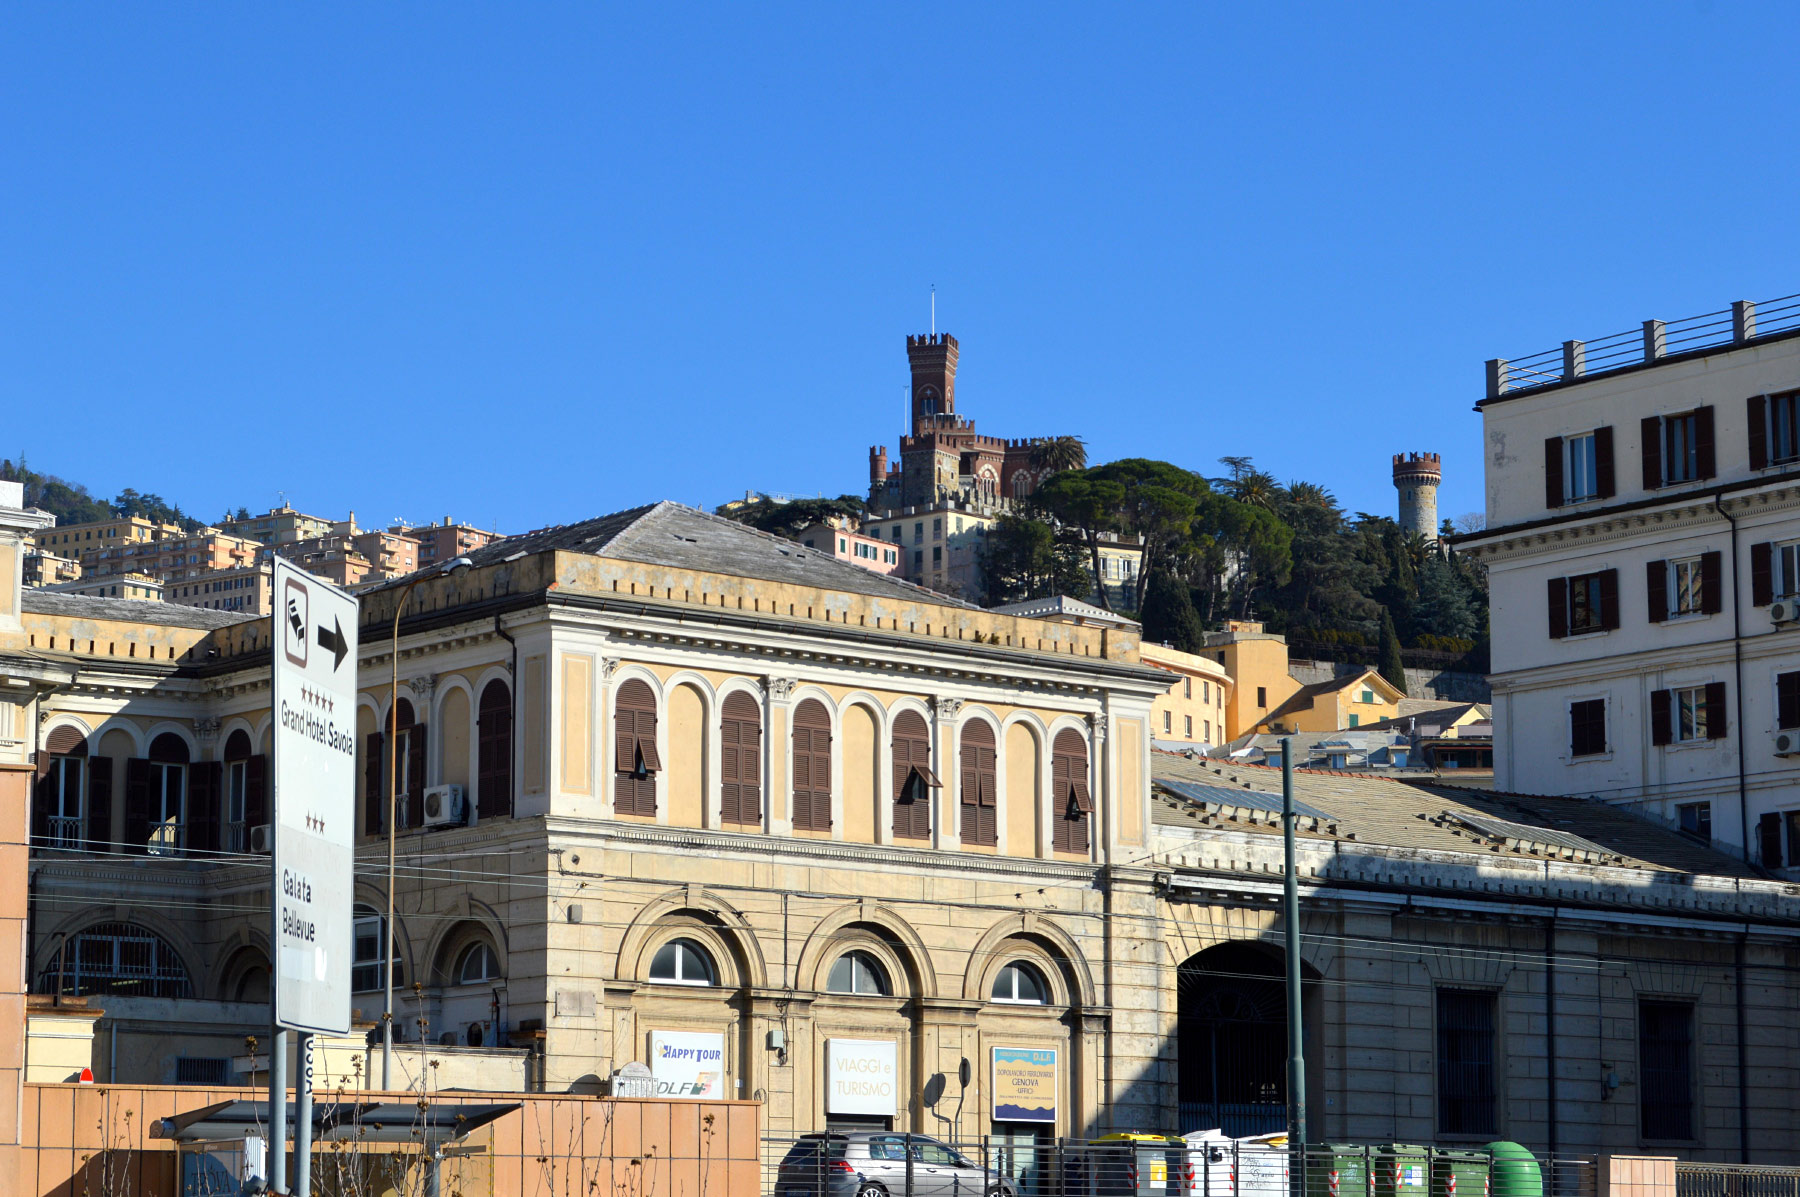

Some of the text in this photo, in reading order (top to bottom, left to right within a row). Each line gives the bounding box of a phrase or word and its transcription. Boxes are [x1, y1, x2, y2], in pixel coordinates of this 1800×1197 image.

[282, 699, 353, 756] Grand Hotel Savoia
[283, 868, 312, 903] Galata
[283, 906, 315, 943] Bellevue
[663, 1045, 721, 1063] HAPPY TOUR
[836, 1058, 891, 1074] VIAGGI e
[657, 1081, 693, 1095] DLF
[836, 1080, 891, 1097] TURISMO
[1012, 1078, 1039, 1087] GENOVA
